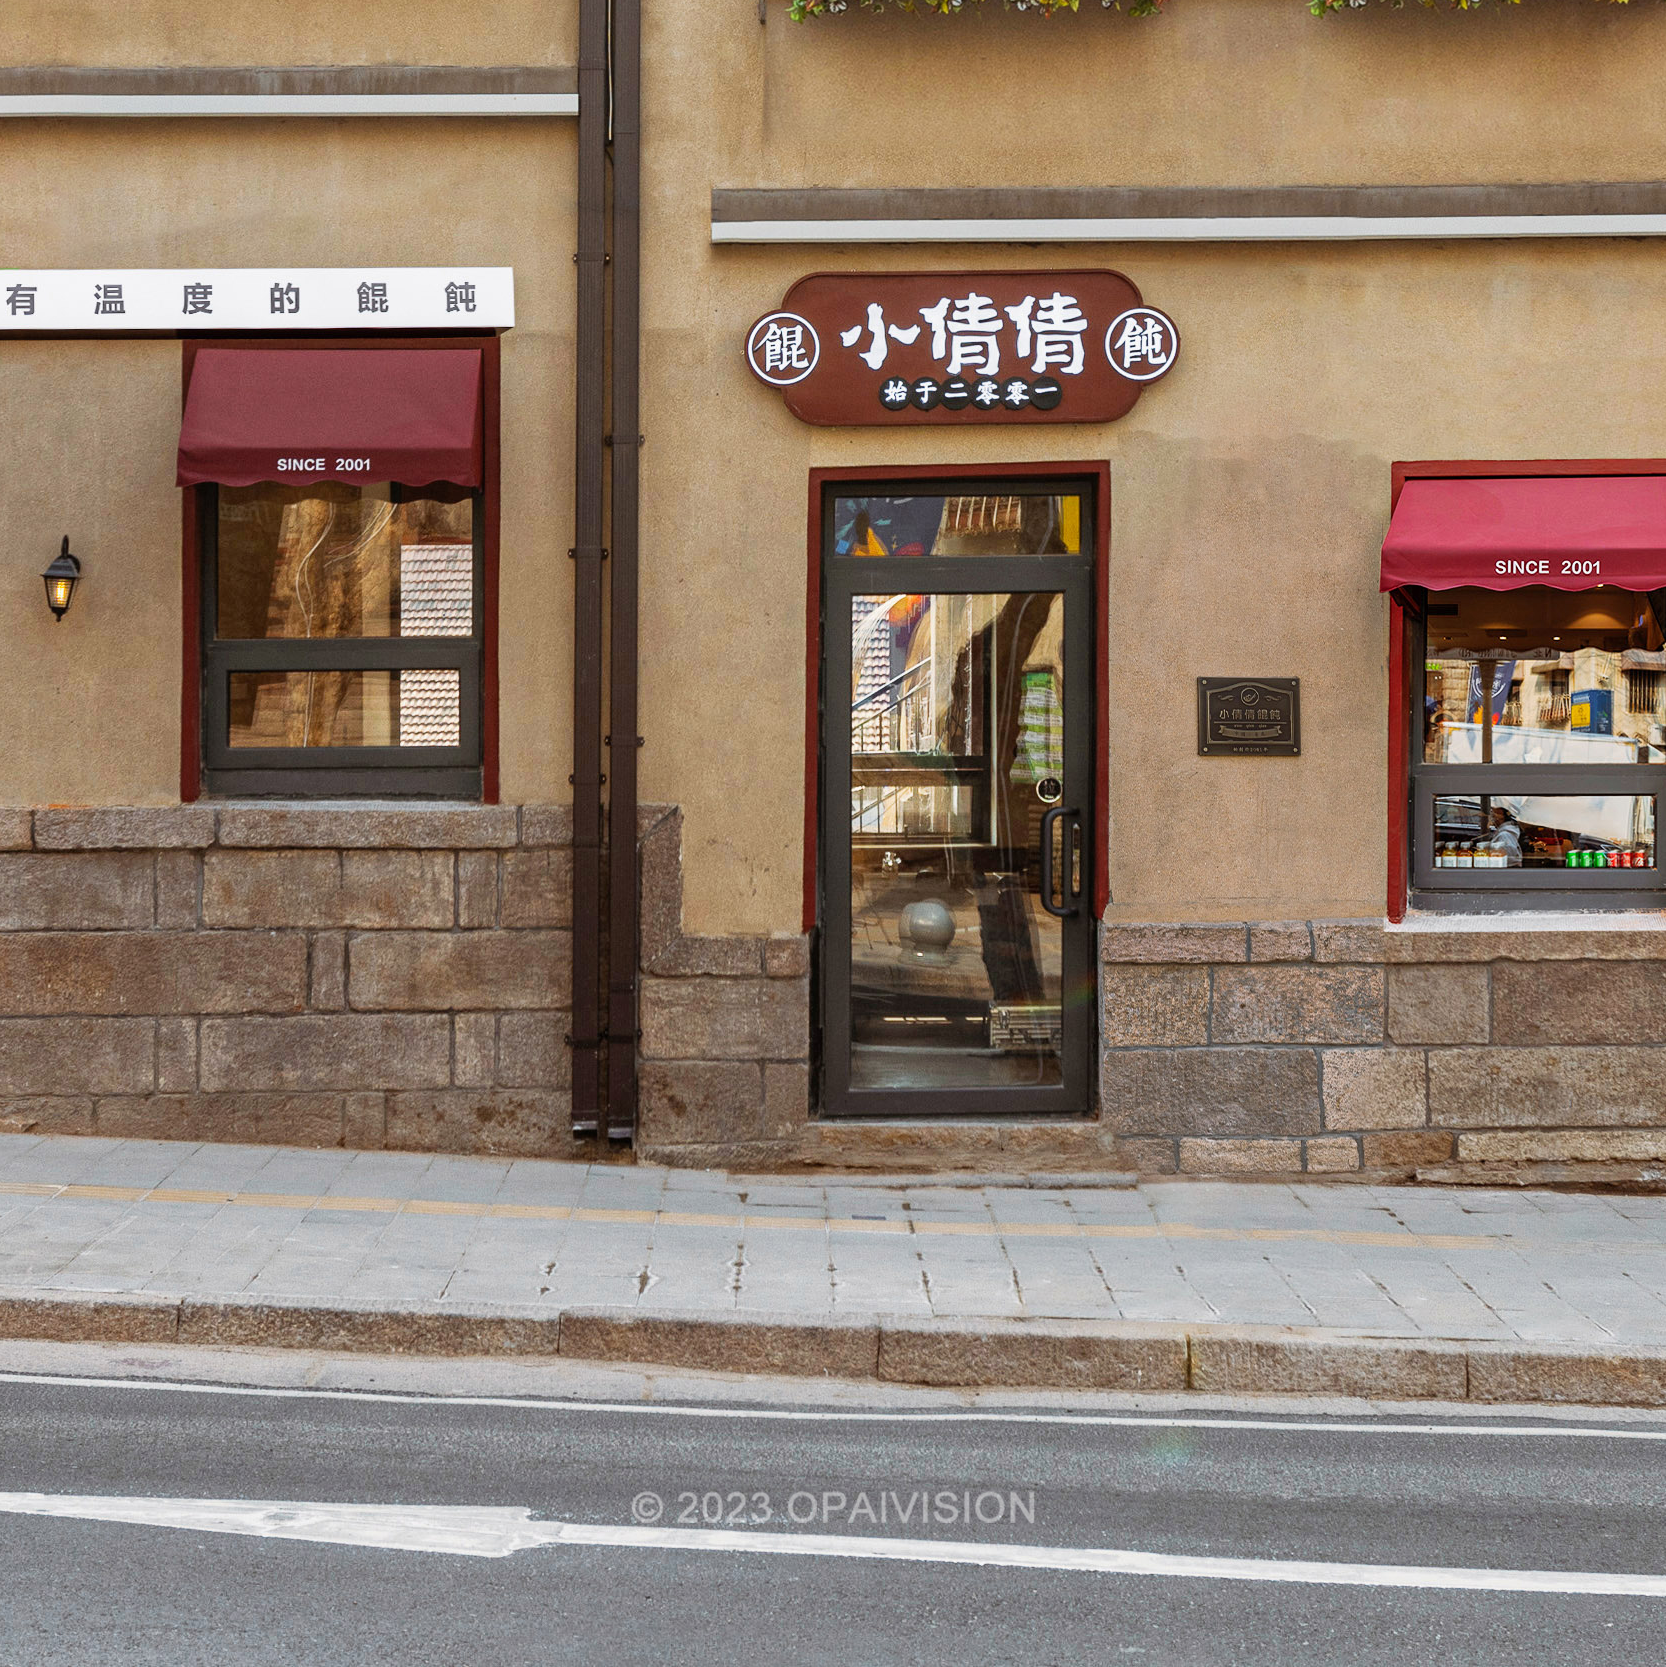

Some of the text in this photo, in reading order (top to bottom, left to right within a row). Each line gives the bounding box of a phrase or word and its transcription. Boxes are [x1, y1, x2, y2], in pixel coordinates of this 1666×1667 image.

[840, 292, 1088, 376] 小倩倩
[884, 379, 1060, 404] 始于二零零一
[277, 458, 372, 472] SINCE 2001
[1495, 560, 1601, 575] SINCE 2001
